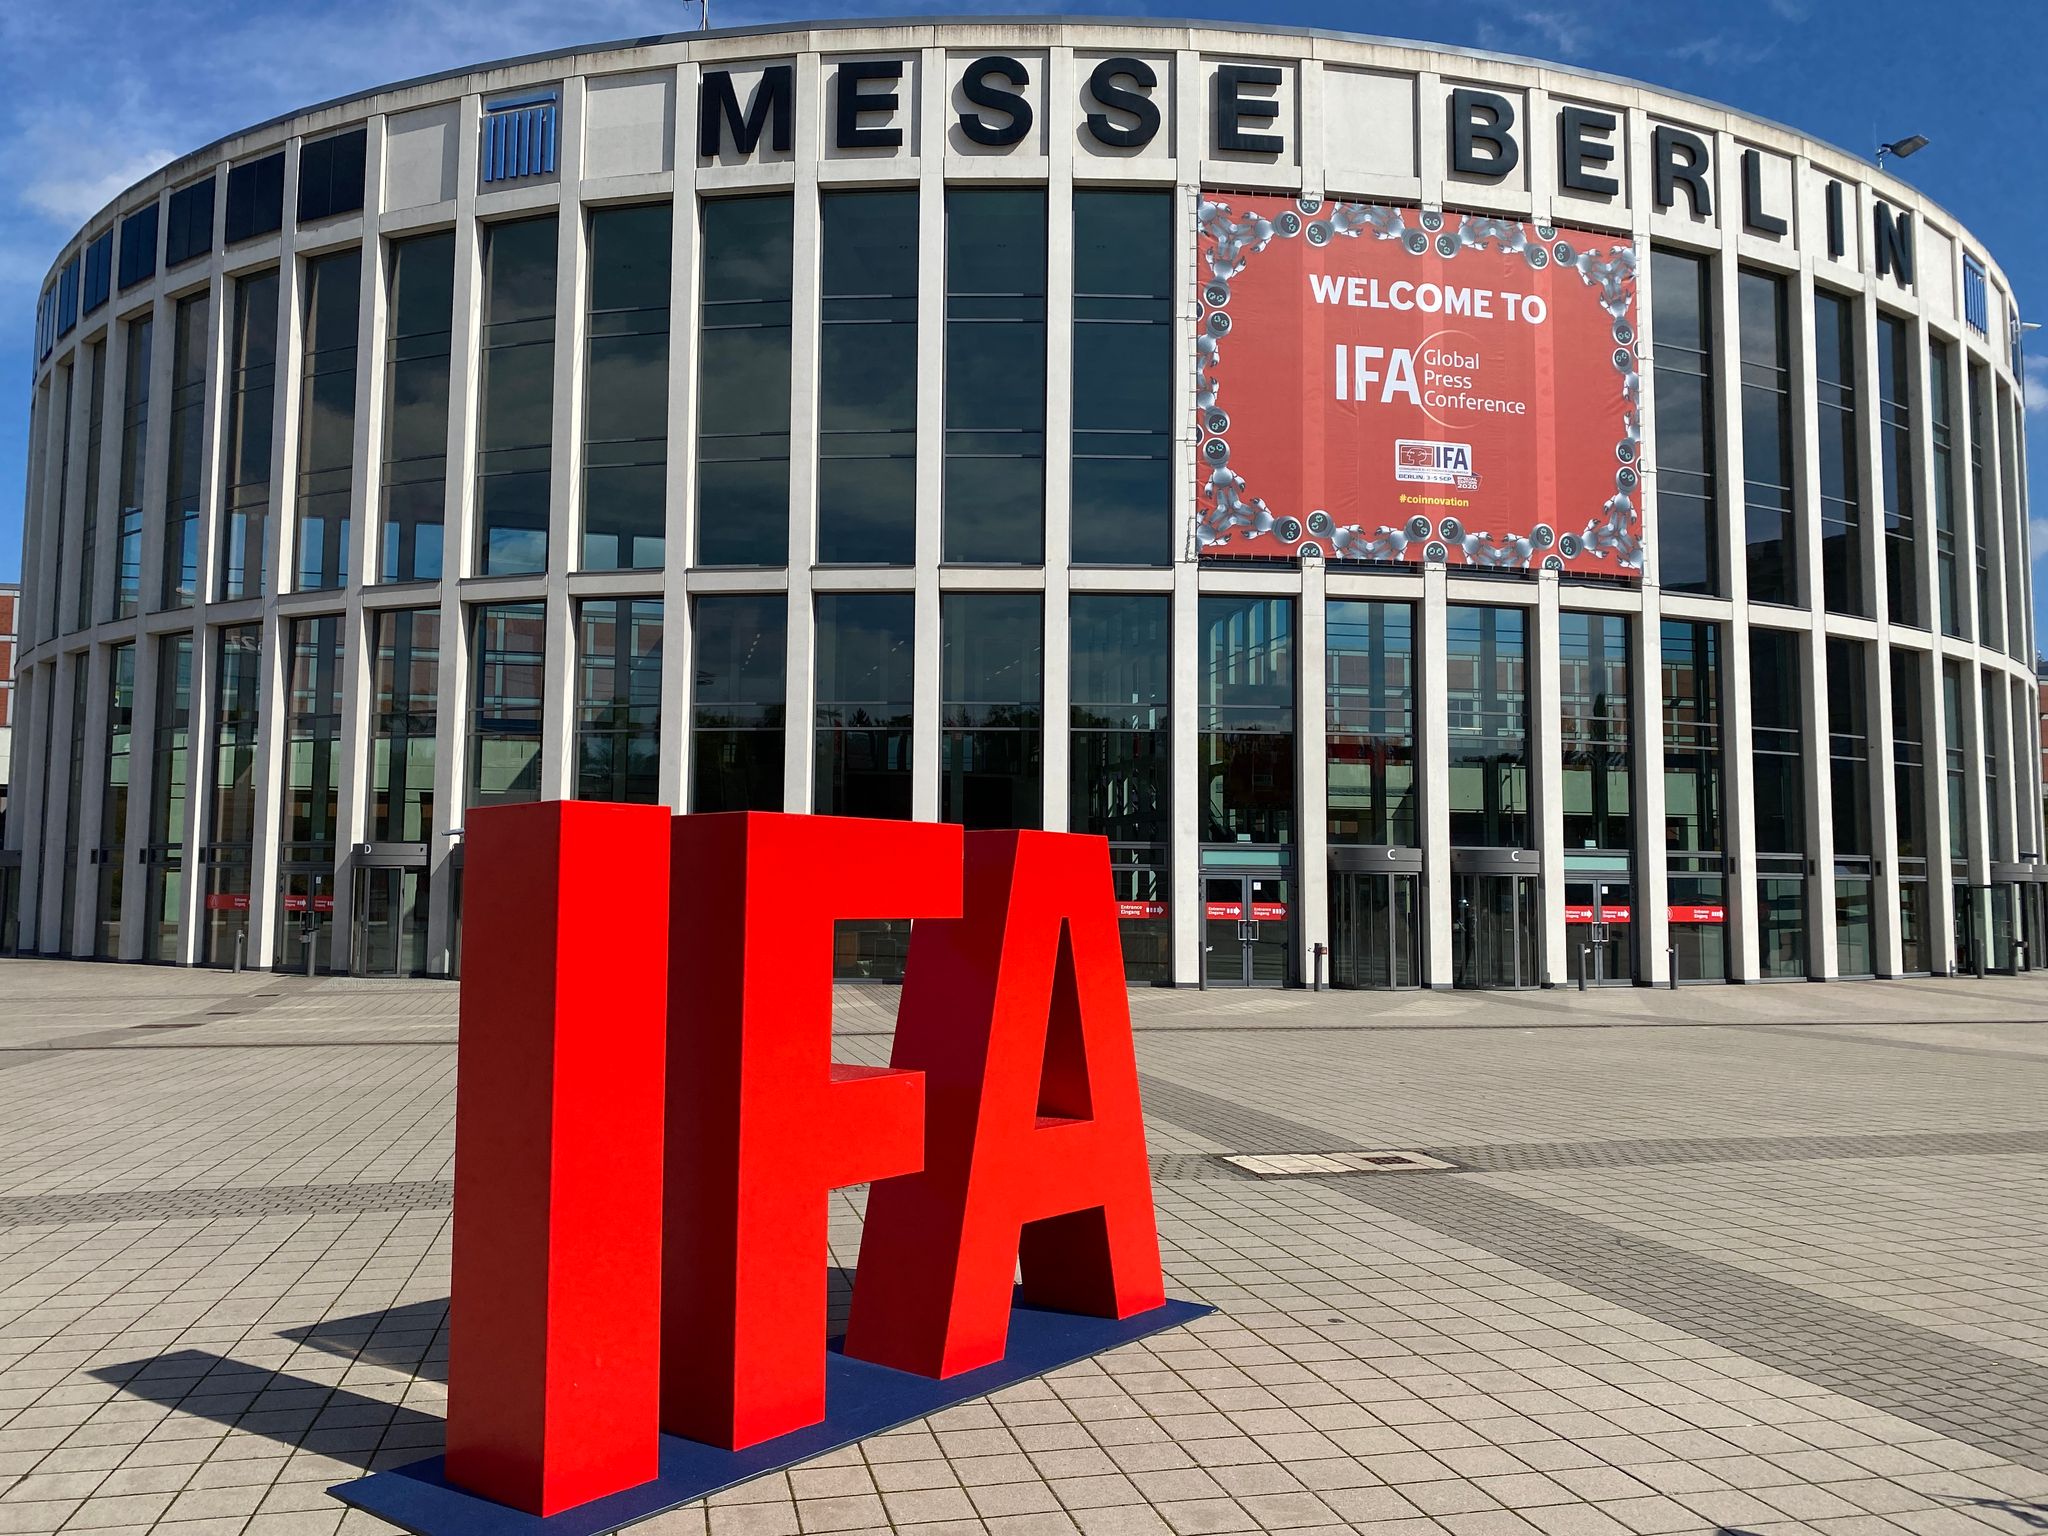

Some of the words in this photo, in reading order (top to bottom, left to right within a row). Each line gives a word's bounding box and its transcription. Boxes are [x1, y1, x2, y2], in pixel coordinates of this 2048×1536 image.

[700, 56, 1284, 157] MESSE
[1452, 88, 1914, 285] BERLIN
[1309, 274, 1493, 319] WELCOME
[1501, 292, 1547, 324] TO
[1424, 350, 1480, 370] Global
[1336, 344, 1421, 405] IFA
[1424, 370, 1472, 389] Press
[1424, 390, 1526, 415] Conference
[1436, 446, 1468, 470] IFA
[1399, 494, 1469, 507] #coinnovation
[364, 844, 372, 854] D
[1387, 849, 1396, 861] C
[1511, 851, 1519, 862] C
[445, 800, 1166, 1518] IFA
